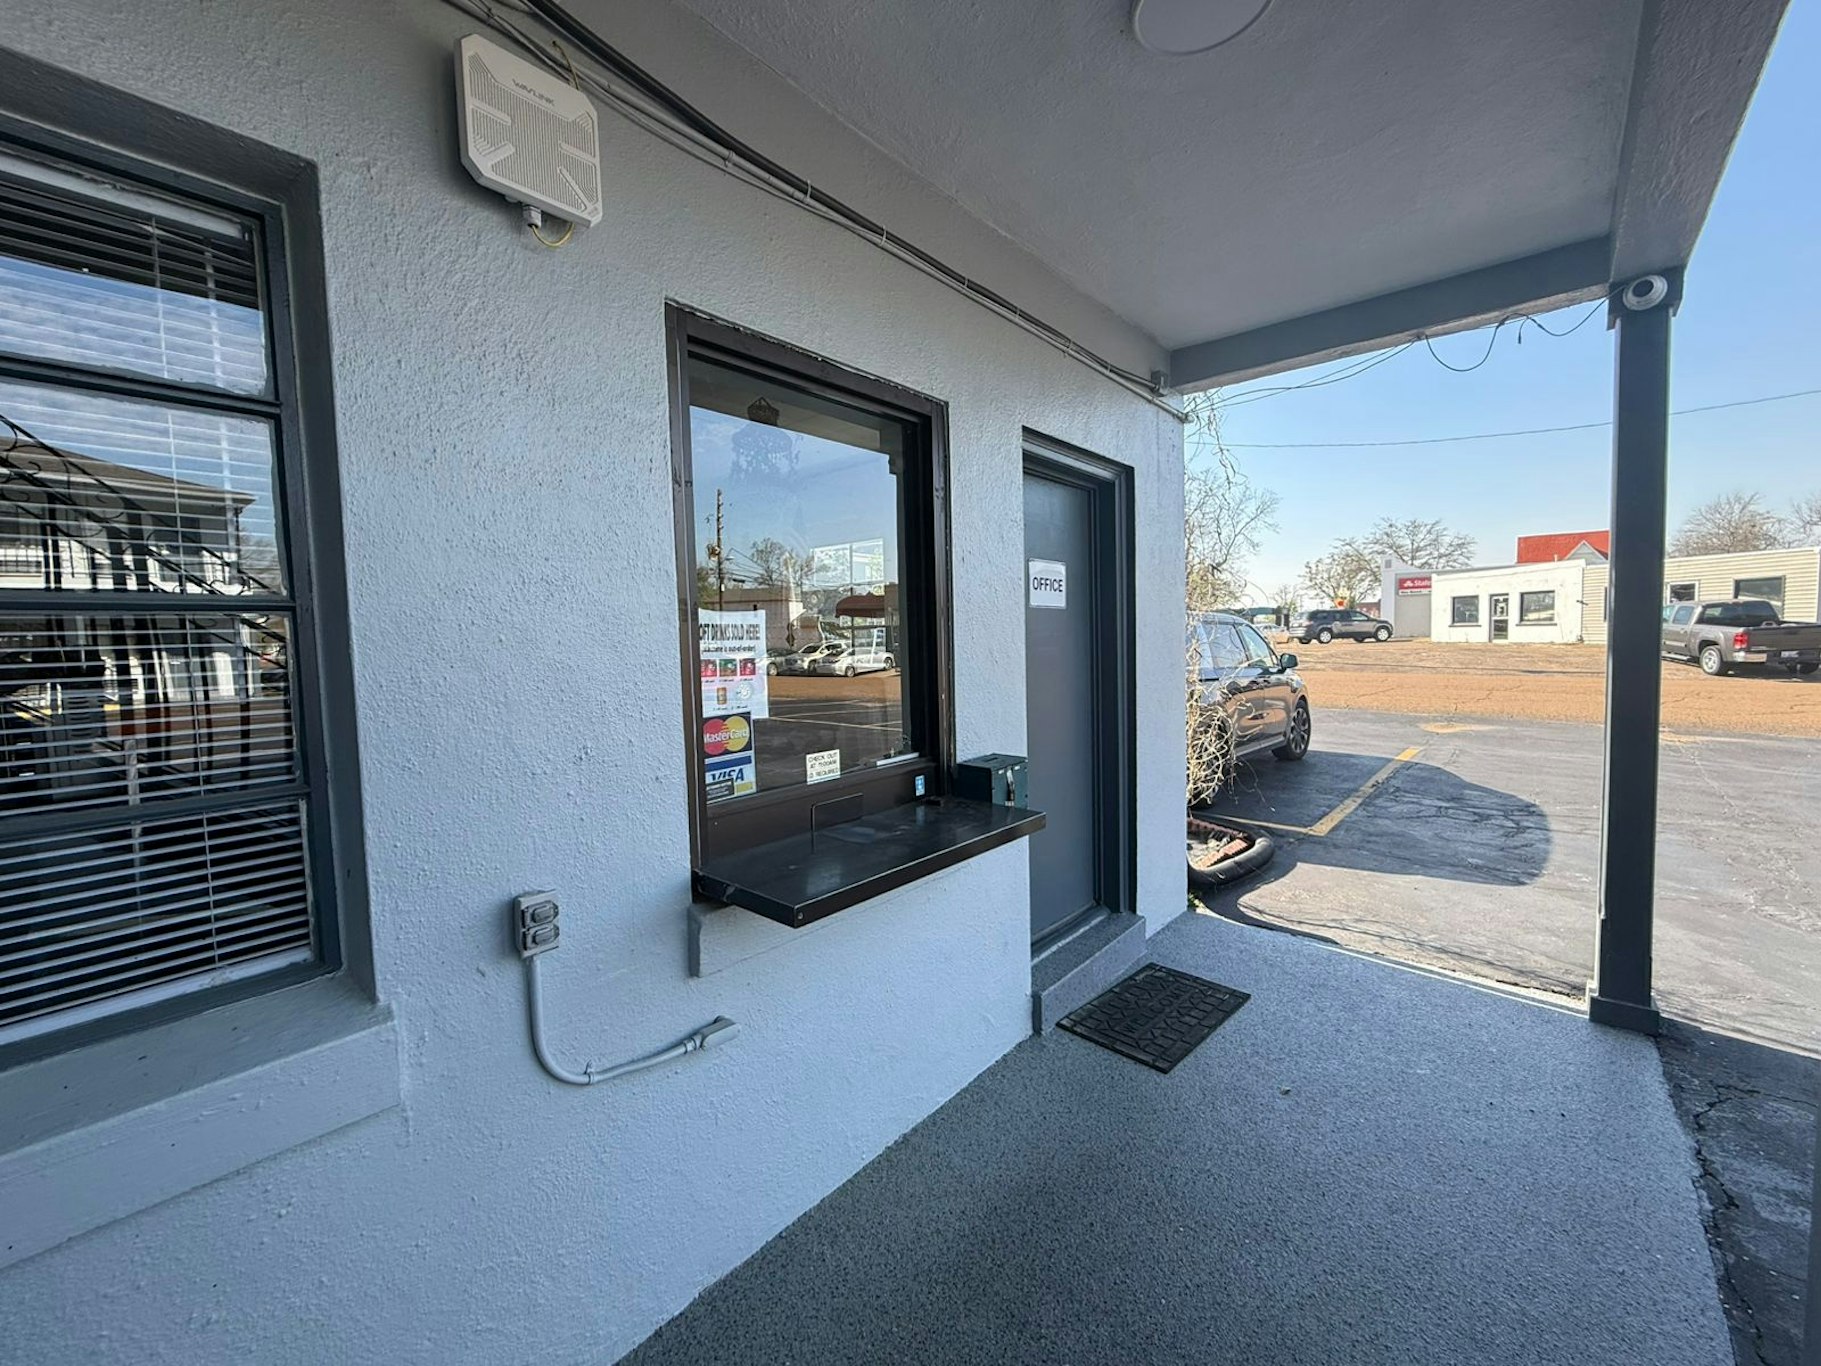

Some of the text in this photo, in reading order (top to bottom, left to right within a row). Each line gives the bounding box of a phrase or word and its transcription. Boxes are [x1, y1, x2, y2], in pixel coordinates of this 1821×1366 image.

[1033, 577, 1063, 592] OFFICE
[699, 623, 710, 641] OFT
[711, 623, 731, 641] DRINKS
[731, 623, 744, 641] SOLD
[711, 768, 745, 782] VISA
